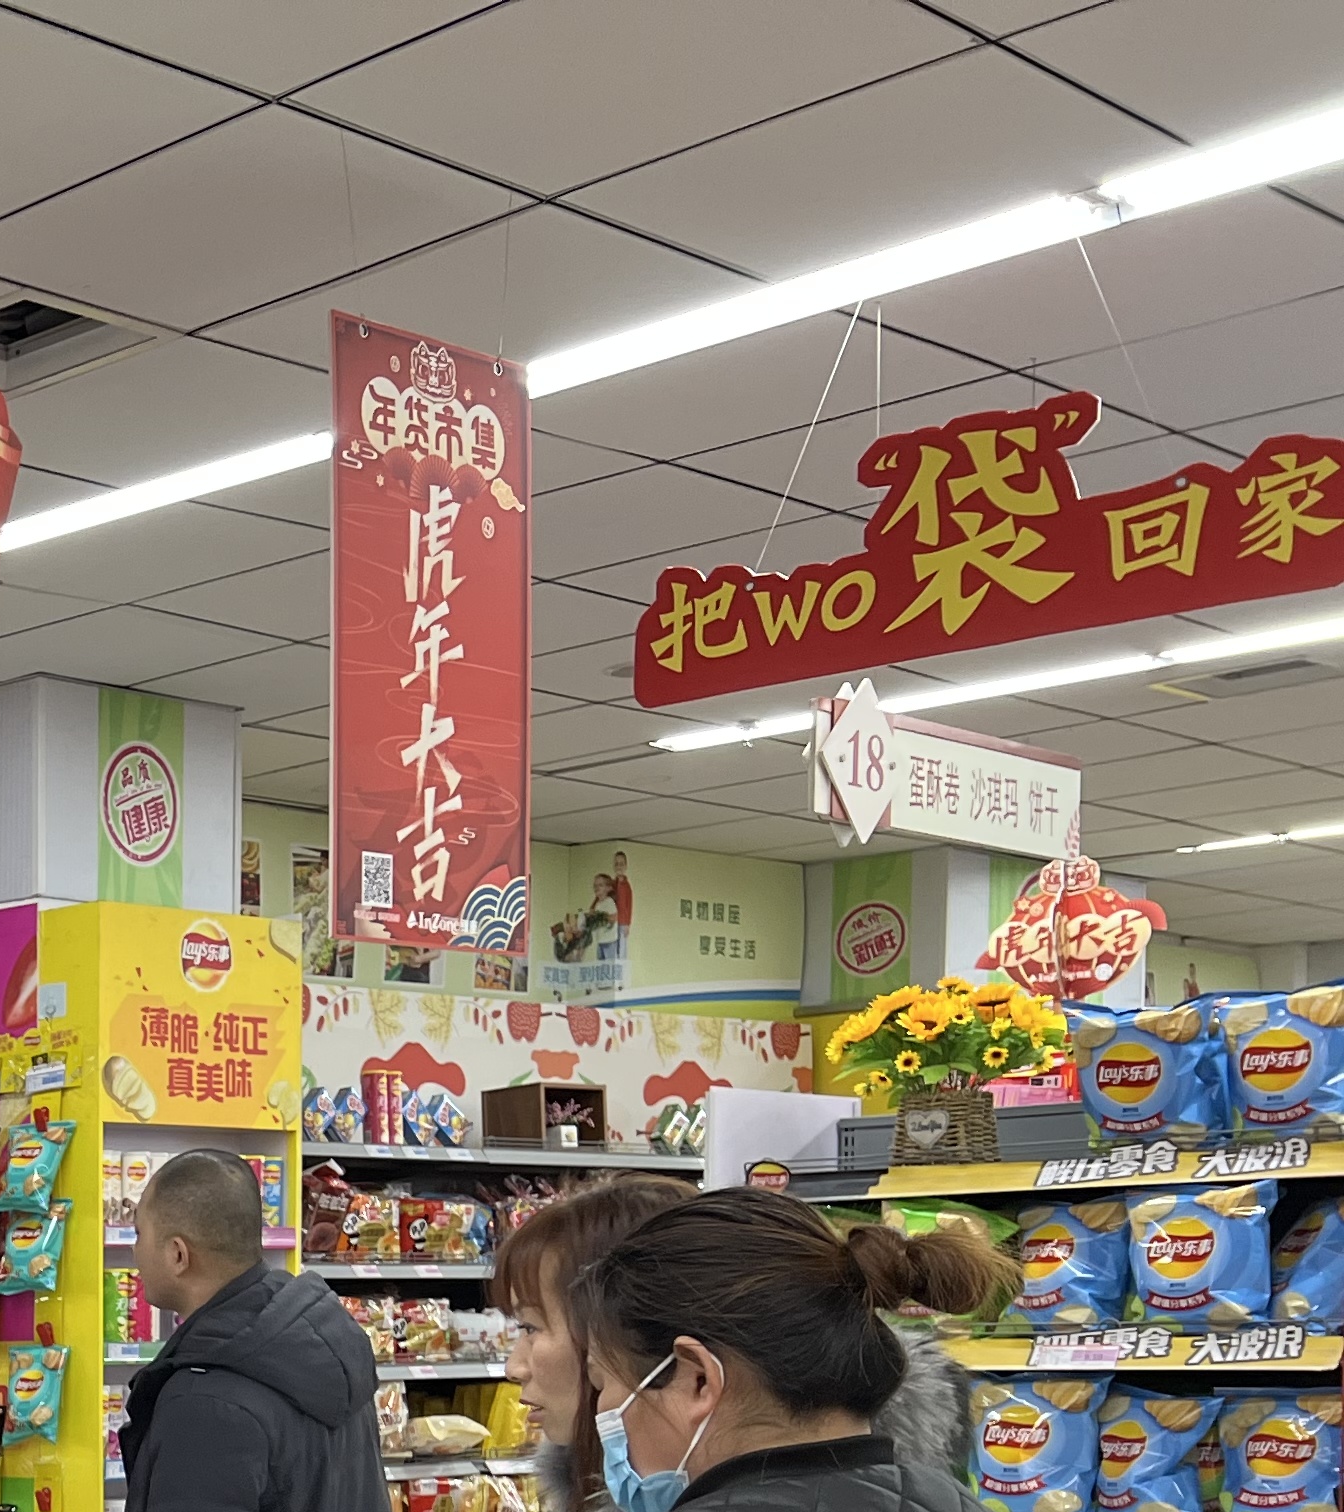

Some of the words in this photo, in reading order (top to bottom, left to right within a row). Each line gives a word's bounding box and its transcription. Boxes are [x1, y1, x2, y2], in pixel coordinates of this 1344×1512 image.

[366, 381, 502, 476] 年货市集
[397, 485, 466, 902] 虎年大吉
[120, 759, 151, 788] 品质
[847, 730, 885, 791] 18
[908, 755, 960, 813] 蛋酥卷
[970, 769, 1019, 829] 沙琪玛
[1029, 785, 1060, 836] 饼干
[121, 795, 170, 845] 健康
[996, 914, 1143, 958] 虎年大吉
[165, 1058, 253, 1101] 真美味
[1035, 1140, 1178, 1186] 解压零食
[1200, 1138, 1309, 1179] 大波浪
[1187, 1326, 1304, 1366] 大波浪
